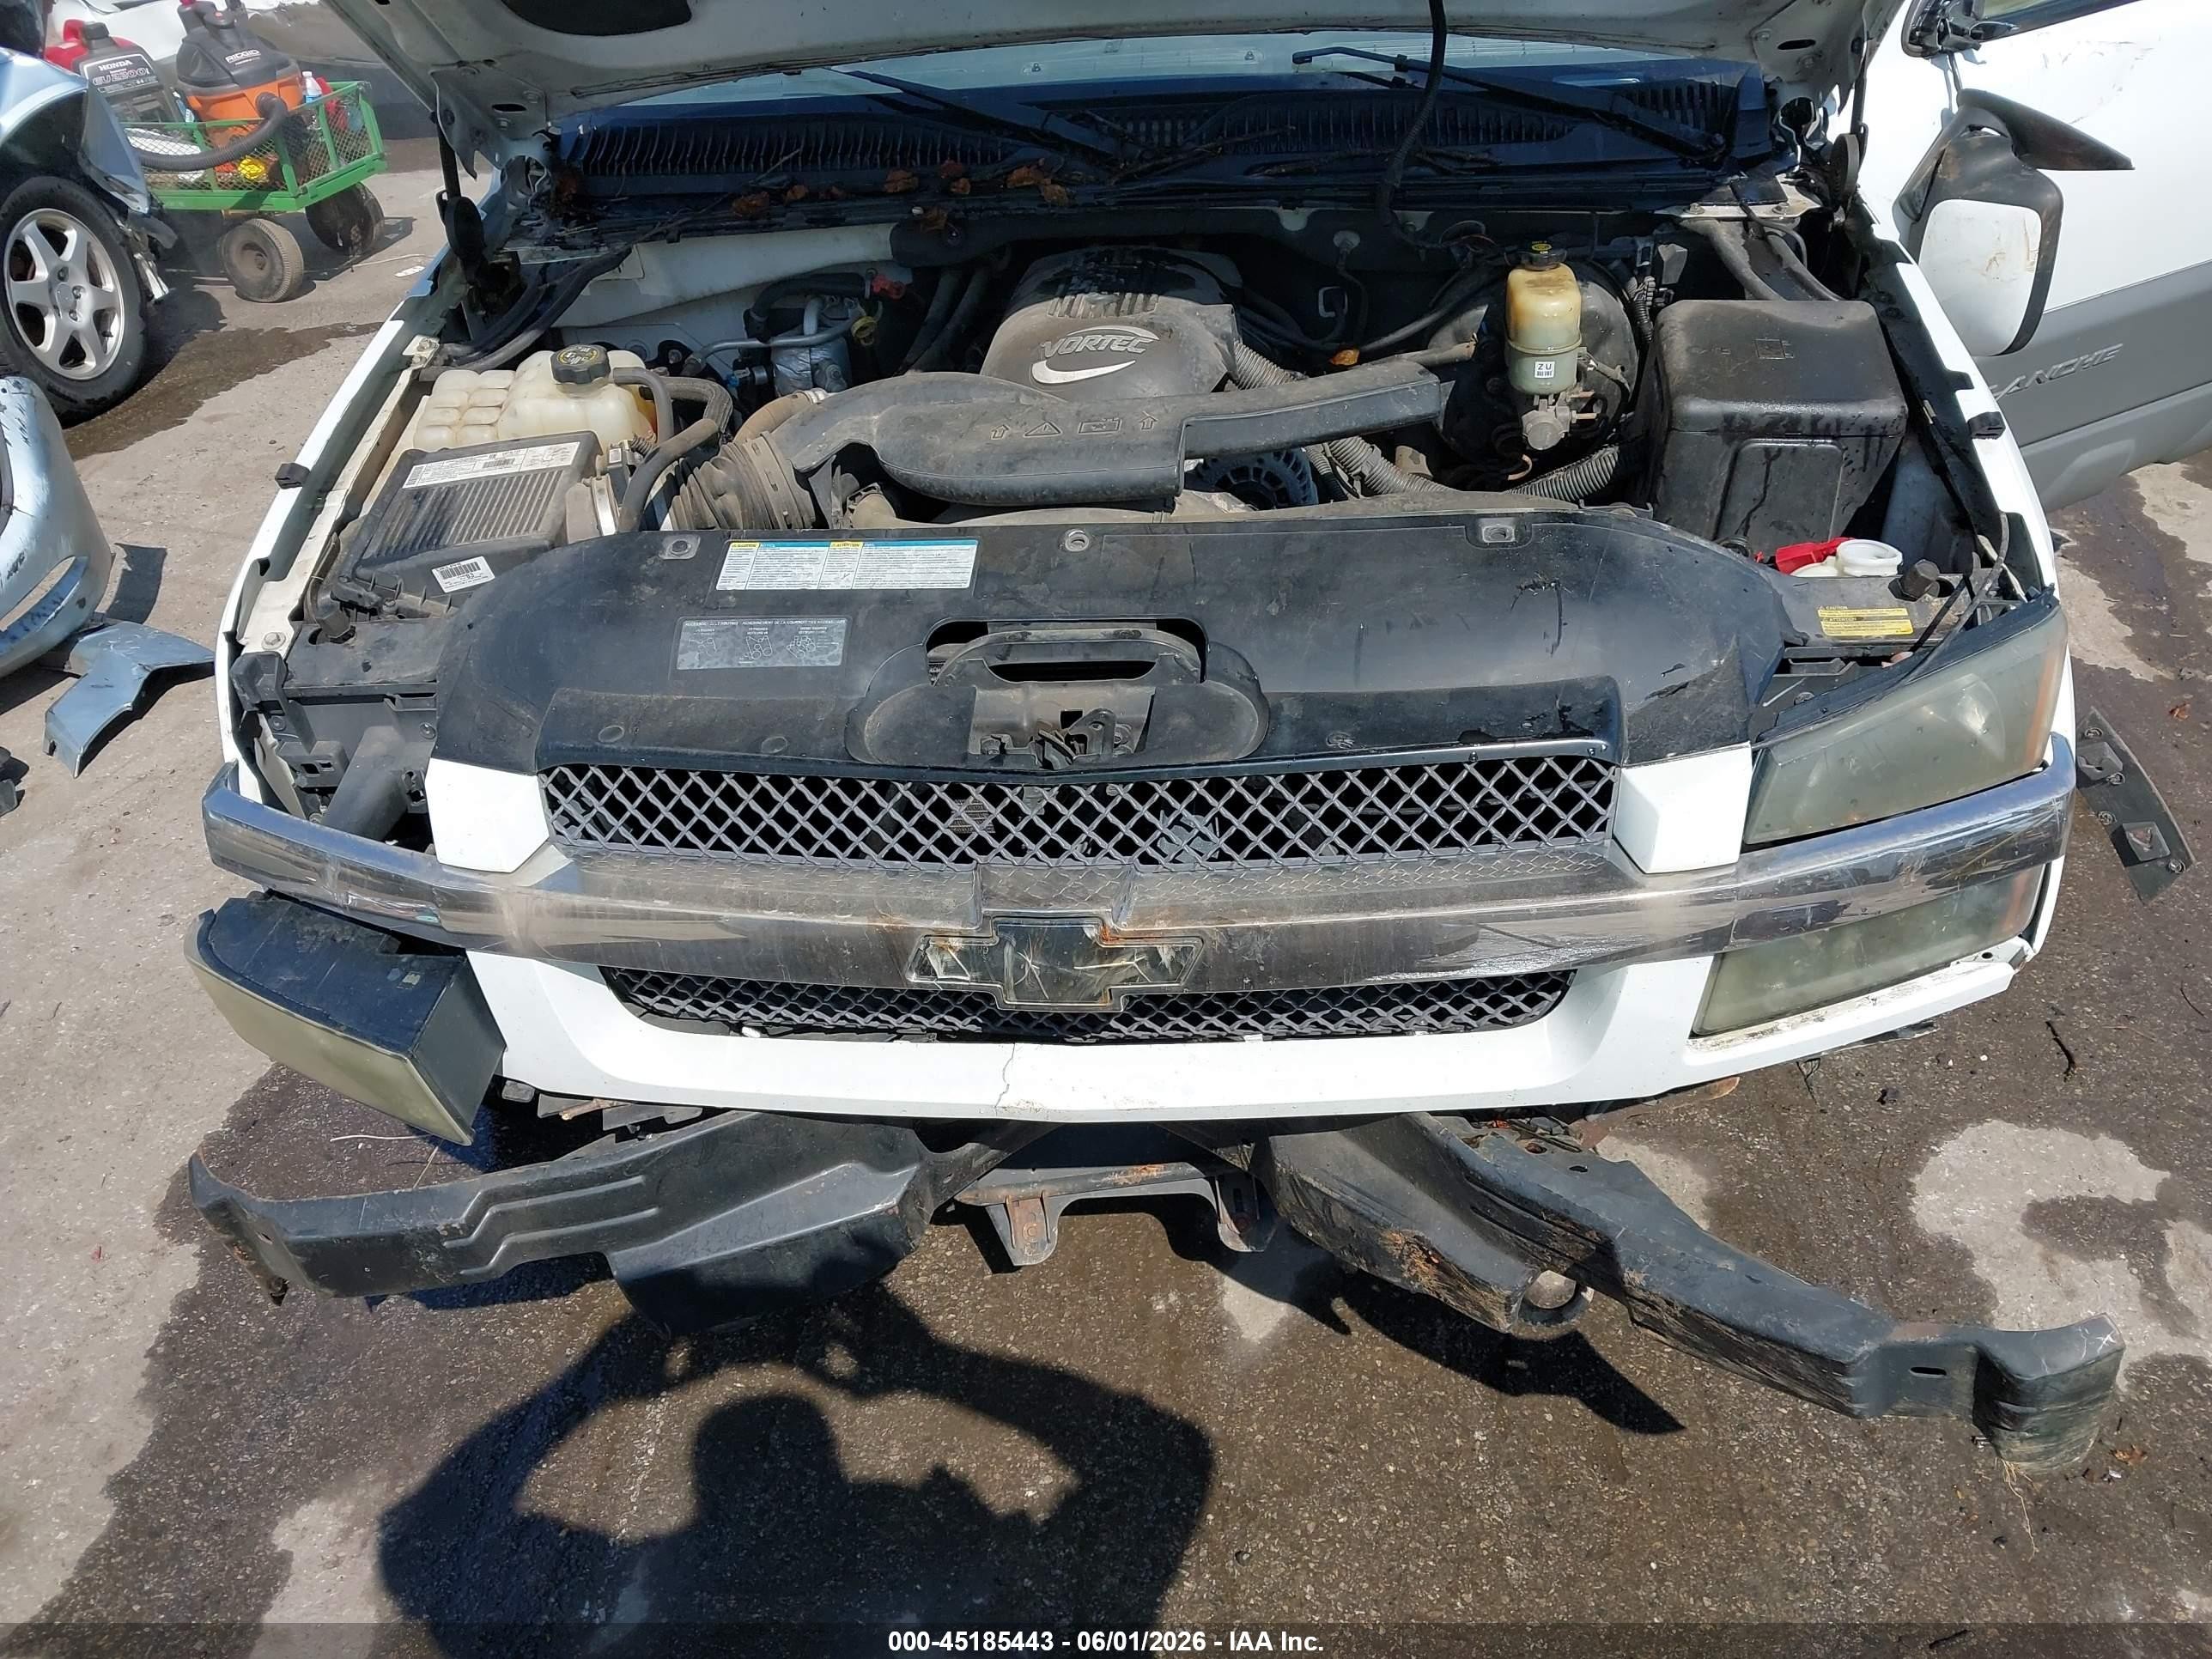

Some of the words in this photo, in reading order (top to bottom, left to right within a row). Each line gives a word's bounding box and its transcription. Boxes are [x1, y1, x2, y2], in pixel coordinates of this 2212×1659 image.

[225, 49, 261, 64] RIDGID
[98, 59, 134, 71] HONDA
[1041, 334, 1155, 358] VORTEC
